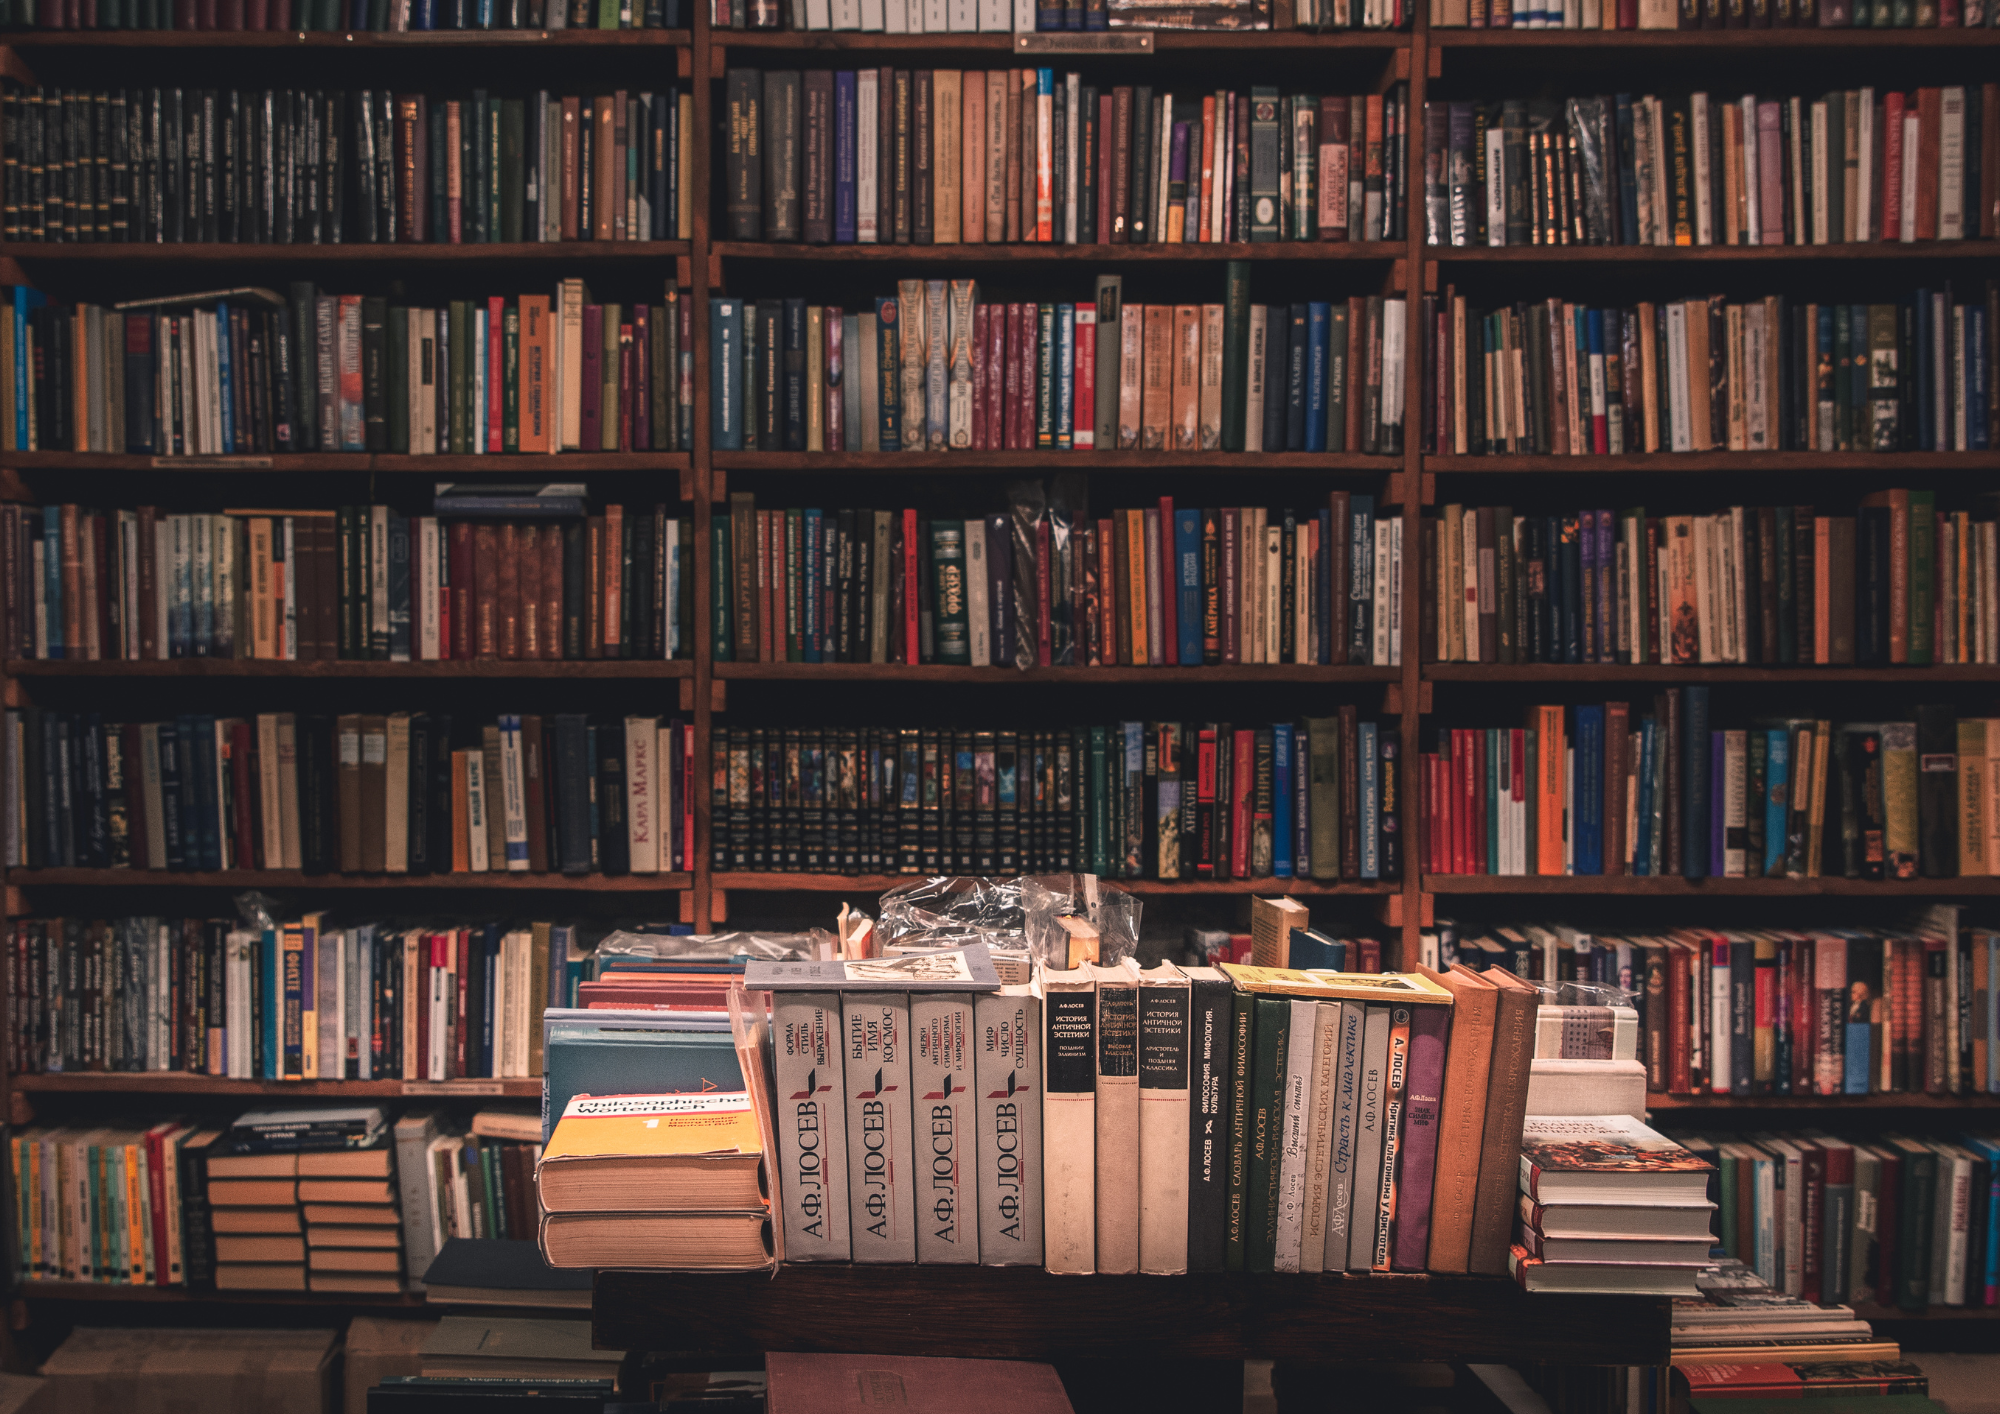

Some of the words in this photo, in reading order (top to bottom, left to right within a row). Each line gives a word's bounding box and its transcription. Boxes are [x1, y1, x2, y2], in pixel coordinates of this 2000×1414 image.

[786, 1022, 794, 1055] ФОРМА
[801, 1022, 809, 1054] СТИЛЬ
[815, 1008, 825, 1066] ВЫРАЖЕНИЕ
[852, 1014, 862, 1059] БЫТИЕ
[867, 1020, 878, 1051] ИМЯ
[882, 1007, 893, 1063] КОСМОС
[986, 1026, 995, 1052] МИФ
[1001, 1021, 1009, 1057] ЧИСЛО
[1015, 1008, 1024, 1069] СУЩНОСТЬ
[1237, 1012, 1247, 1076] ФИЛОСОФИИ
[1275, 1028, 1285, 1083] ЭСТЕТИКА
[1321, 1023, 1334, 1087] КАТЕГОРИЙ
[1394, 1037, 1404, 1049] А.
[1465, 1005, 1482, 1099] ВОЗРОЖДЕНИЯ
[1292, 1074, 1303, 1111] синтез
[1334, 1114, 1350, 1173] Страсть
[1342, 1013, 1358, 1100] диалектике
[1391, 1052, 1403, 1089] ЛОСЕВ
[1210, 1075, 1219, 1114] КУЛЬТУРА
[1234, 1080, 1245, 1138] АНТИЧНОЙ
[642, 1118, 660, 1129] 1
[1286, 1113, 1301, 1158] Высший
[1314, 1090, 1329, 1181] ЭСТЕТИЧЕСКИХ
[1387, 1101, 1400, 1141] Критика
[1459, 1102, 1473, 1161] ЭСТЕТИКА
[1232, 1141, 1243, 1186] СЛОВАРЬ
[1288, 1174, 1297, 1197] Лосев
[1383, 1144, 1395, 1199] платонизма
[1310, 1183, 1322, 1237] ИСТОРИЯ
[1377, 1210, 1390, 1266] Аристотеля
